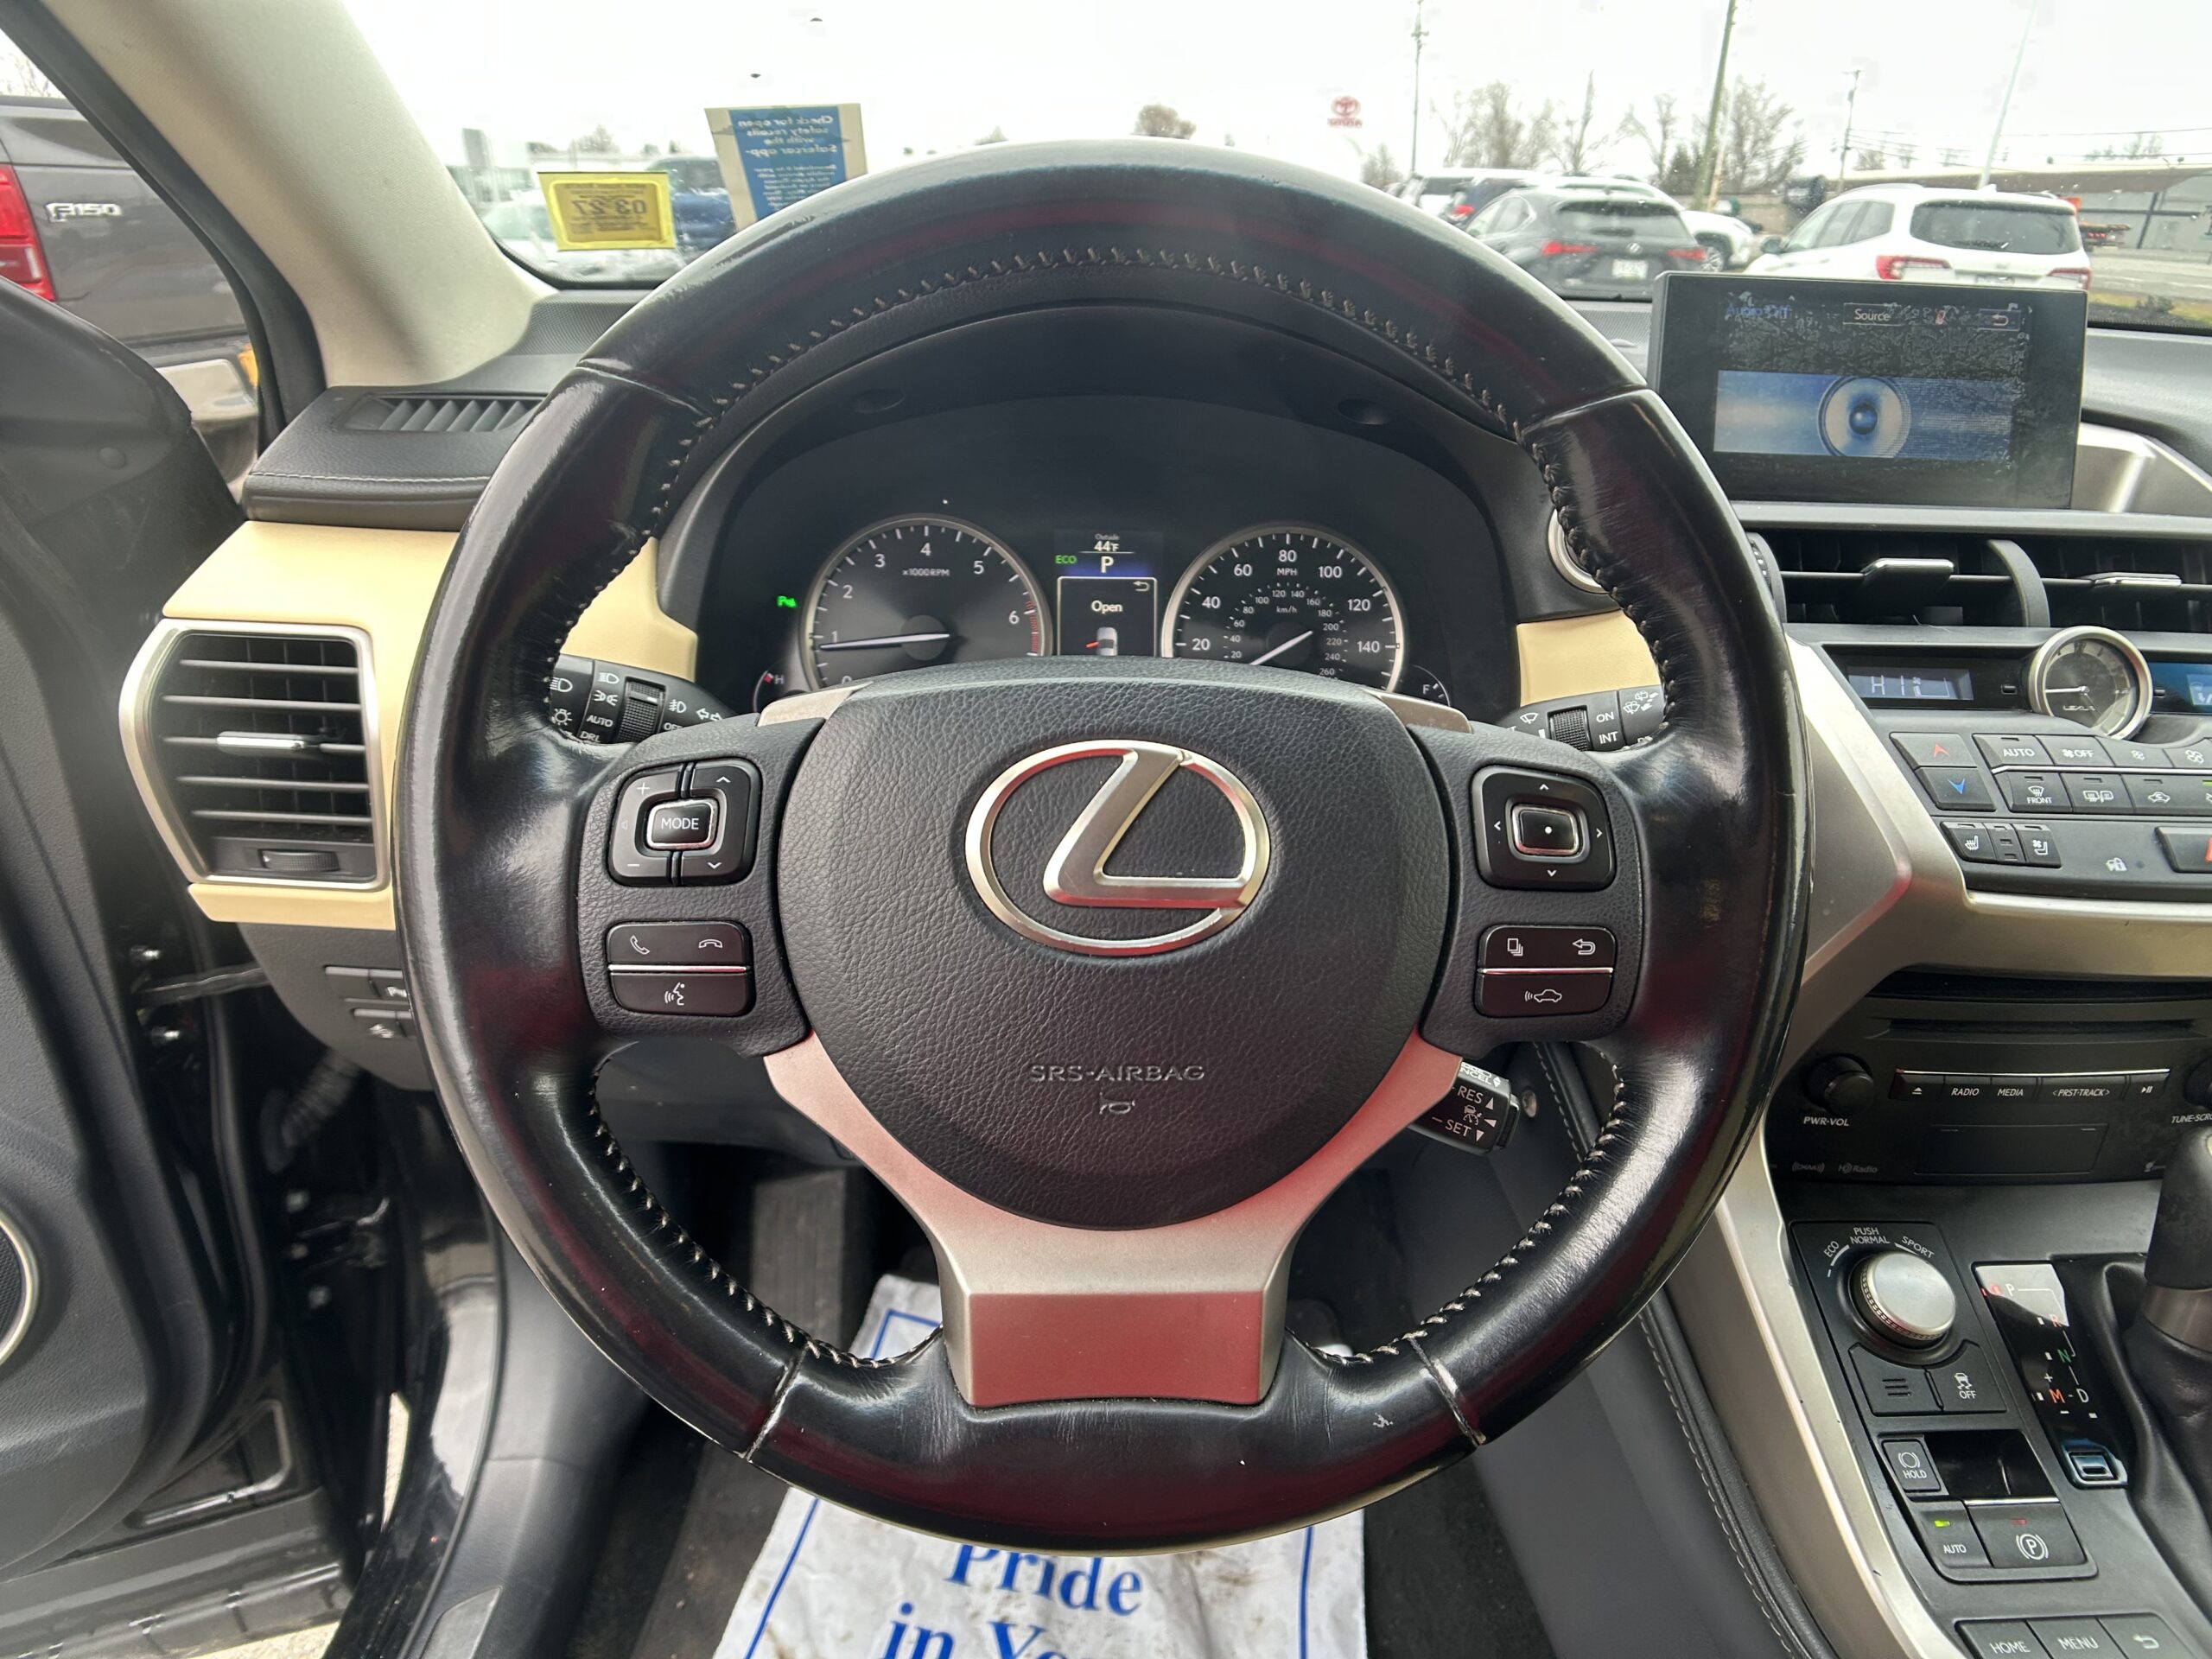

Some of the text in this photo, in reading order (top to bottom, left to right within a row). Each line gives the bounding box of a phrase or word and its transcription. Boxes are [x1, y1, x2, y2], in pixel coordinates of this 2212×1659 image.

[1854, 308, 1891, 321] Source
[920, 543, 931, 556] 4
[1278, 550, 1297, 562] 80
[874, 554, 886, 568] 3
[1055, 555, 1077, 564] ECO
[1100, 556, 1115, 574] P
[973, 561, 984, 575] 5
[1233, 564, 1252, 576] 60
[1276, 567, 1297, 576] MPH
[1318, 566, 1343, 578] 100
[842, 584, 854, 599] 2
[1272, 589, 1287, 598] 120
[1091, 600, 1123, 614] Open
[1202, 596, 1221, 608] 40
[1255, 596, 1269, 605] 100
[1348, 599, 1370, 611] 120
[1008, 610, 1020, 625] 6
[1318, 609, 1332, 618] 180
[1323, 622, 1339, 631] 200
[1192, 638, 1211, 651] 20
[1357, 640, 1381, 653] 140
[1325, 652, 1340, 661] 240
[587, 715, 613, 728] AUTO
[1596, 711, 1615, 723] ON
[1599, 731, 1618, 744] INT
[2003, 747, 2035, 757] AUTO
[2075, 748, 2094, 758] OFF
[2026, 796, 2053, 804] FRONT
[660, 817, 699, 830] MODE
[1031, 1065, 1205, 1081] SRS-AIRBAG
[1460, 1066, 1492, 1085] NCEL
[1457, 1085, 1484, 1104] RES
[1950, 1087, 1980, 1096] RADIO
[1997, 1088, 2024, 1096] MEDIA
[1445, 1119, 1471, 1137] SET
[1853, 1227, 1879, 1236] PUSH
[1850, 1236, 1891, 1244] NORMAL
[1823, 1241, 1840, 1258] ECO
[1901, 1236, 1935, 1258] SPORT
[2005, 1283, 2015, 1296] P
[2050, 1314, 2062, 1327] R
[2057, 1349, 2071, 1363] N
[1959, 1389, 1976, 1399] OFF
[2049, 1389, 2065, 1403] M
[2076, 1388, 2089, 1402] D
[1902, 1470, 1927, 1479] HOLD
[1943, 1544, 1967, 1554] AUTO
[944, 1544, 1142, 1617] Pride
[1989, 1640, 2030, 1654] HOME
[2057, 1637, 2098, 1649] MENU
